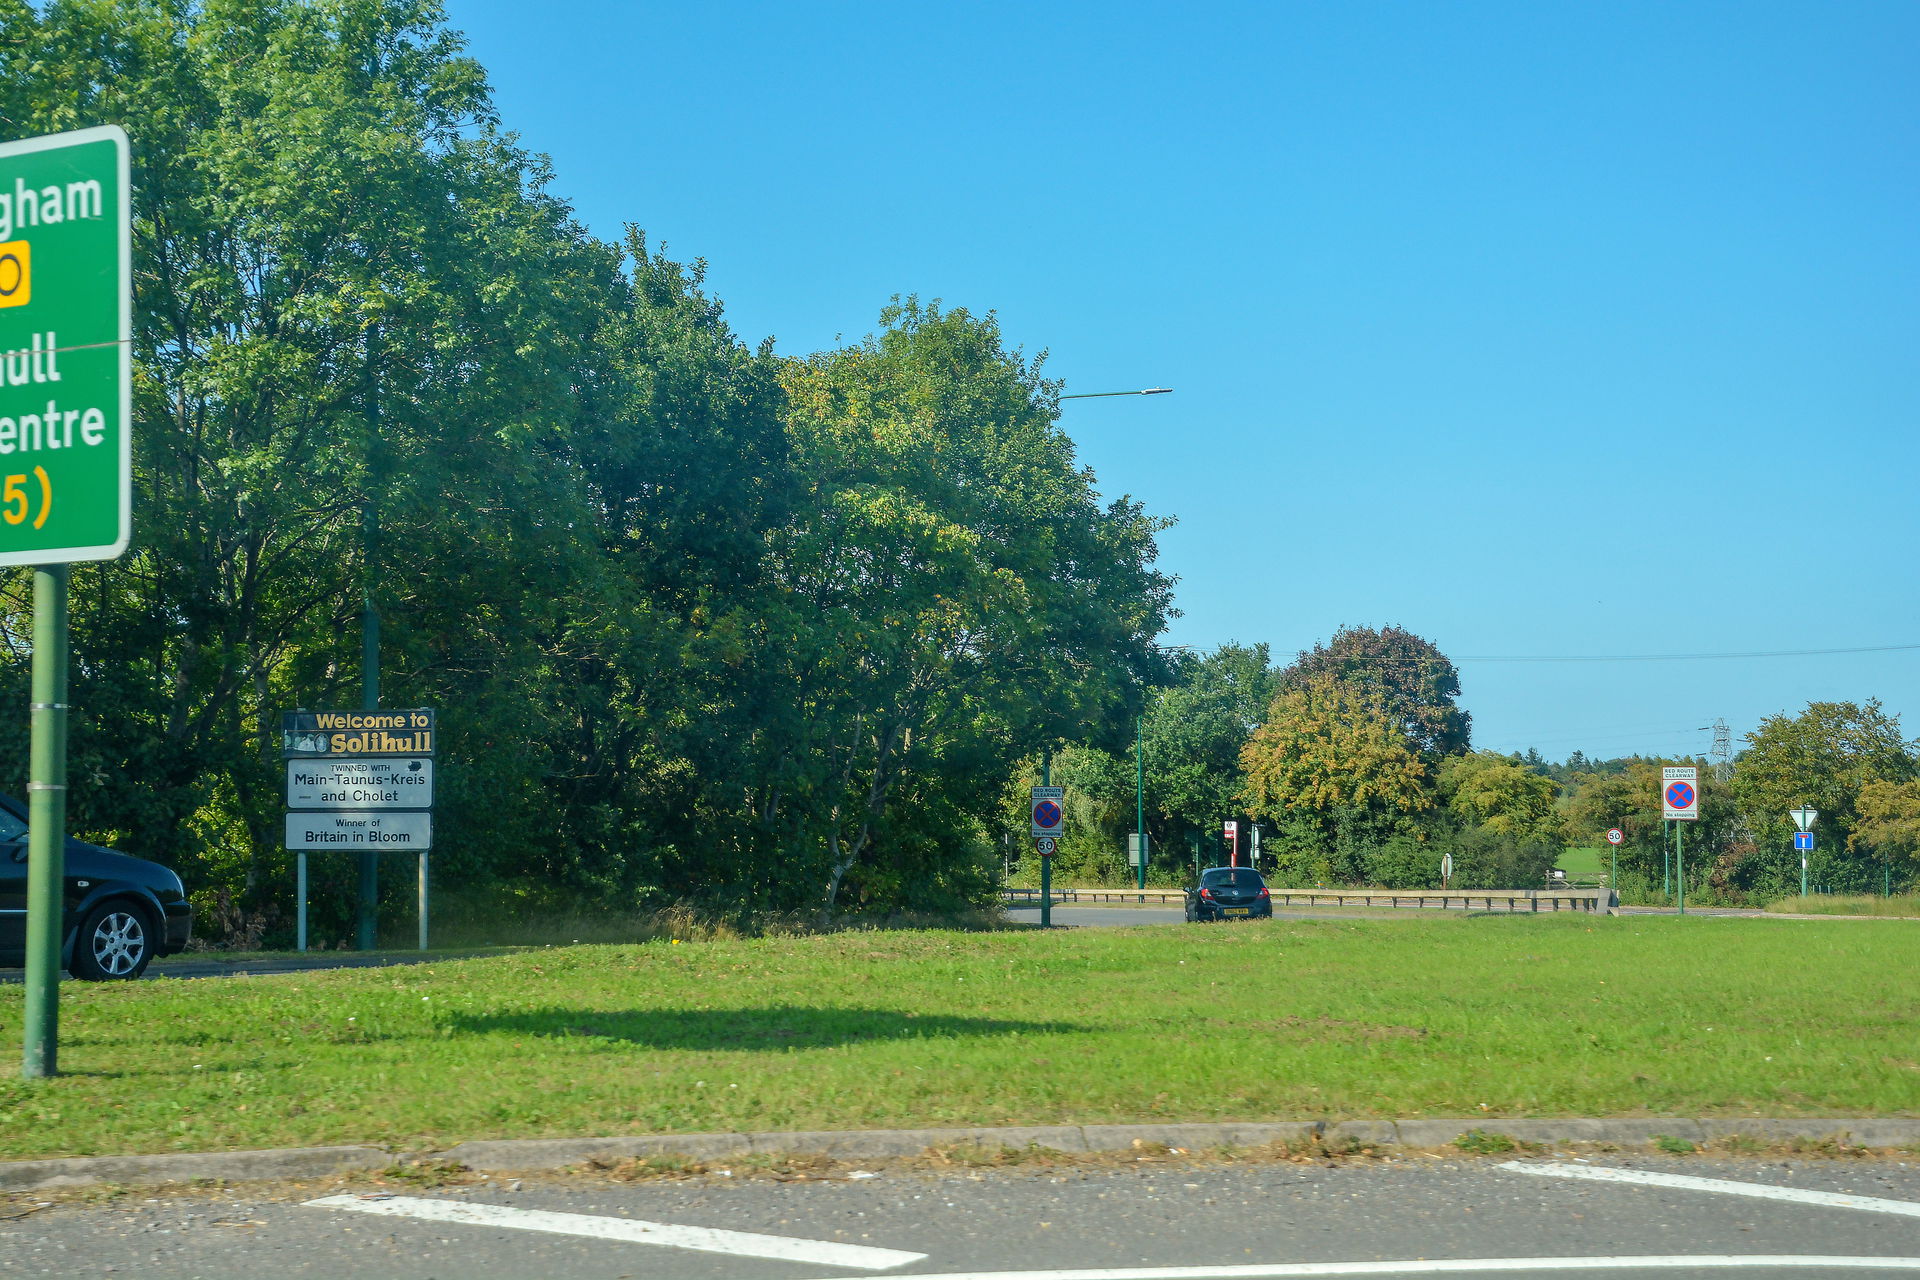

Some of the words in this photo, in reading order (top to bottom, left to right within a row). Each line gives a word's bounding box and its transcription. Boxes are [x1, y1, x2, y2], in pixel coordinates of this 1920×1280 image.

[0, 331, 61, 386] ull
[3, 465, 52, 529] 5)
[316, 713, 406, 729] Welcome
[410, 713, 429, 728] to
[330, 732, 431, 753] Solihull
[331, 764, 368, 772] TWINNED
[370, 764, 390, 772] WITH
[295, 774, 425, 785] Main-Taunus-Kreis
[321, 790, 346, 801] and
[352, 789, 399, 802] Cholet
[335, 819, 367, 828] Winner
[371, 818, 381, 828] of
[305, 830, 348, 843] Britain
[352, 830, 364, 843] in
[369, 831, 410, 843] Bloom
[1609, 832, 1621, 840] 50
[1038, 841, 1053, 850] 50
